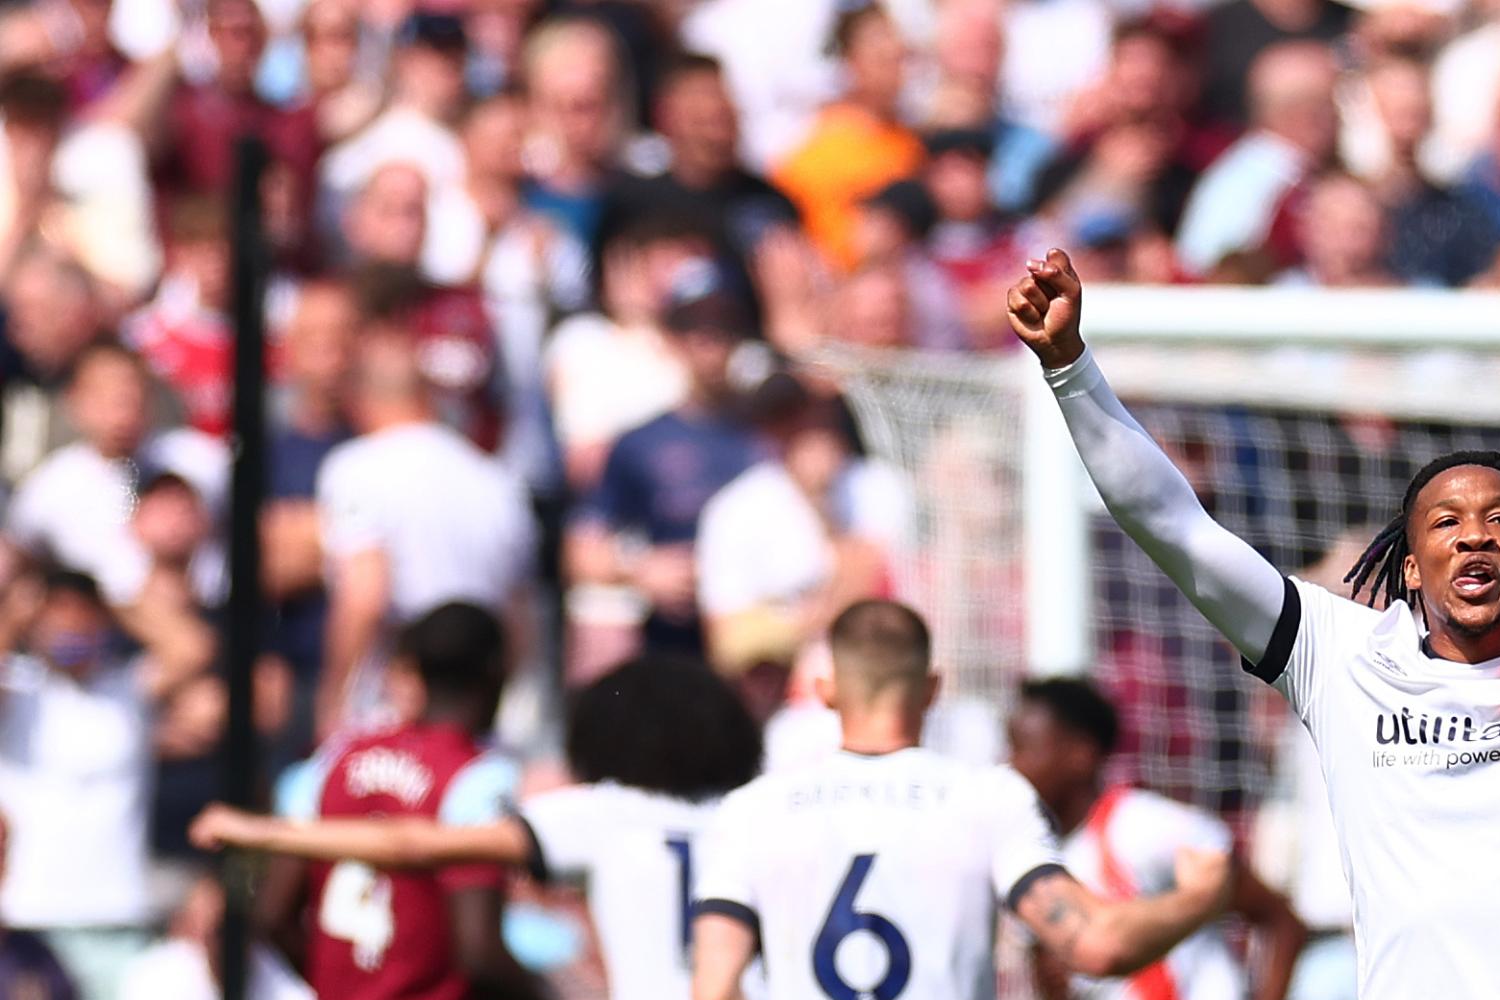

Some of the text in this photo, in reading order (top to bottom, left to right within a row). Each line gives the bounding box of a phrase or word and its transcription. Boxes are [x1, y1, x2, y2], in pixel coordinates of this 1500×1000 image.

[1372, 751, 1397, 768] life
[1402, 750, 1441, 766] with
[319, 859, 395, 974] 4
